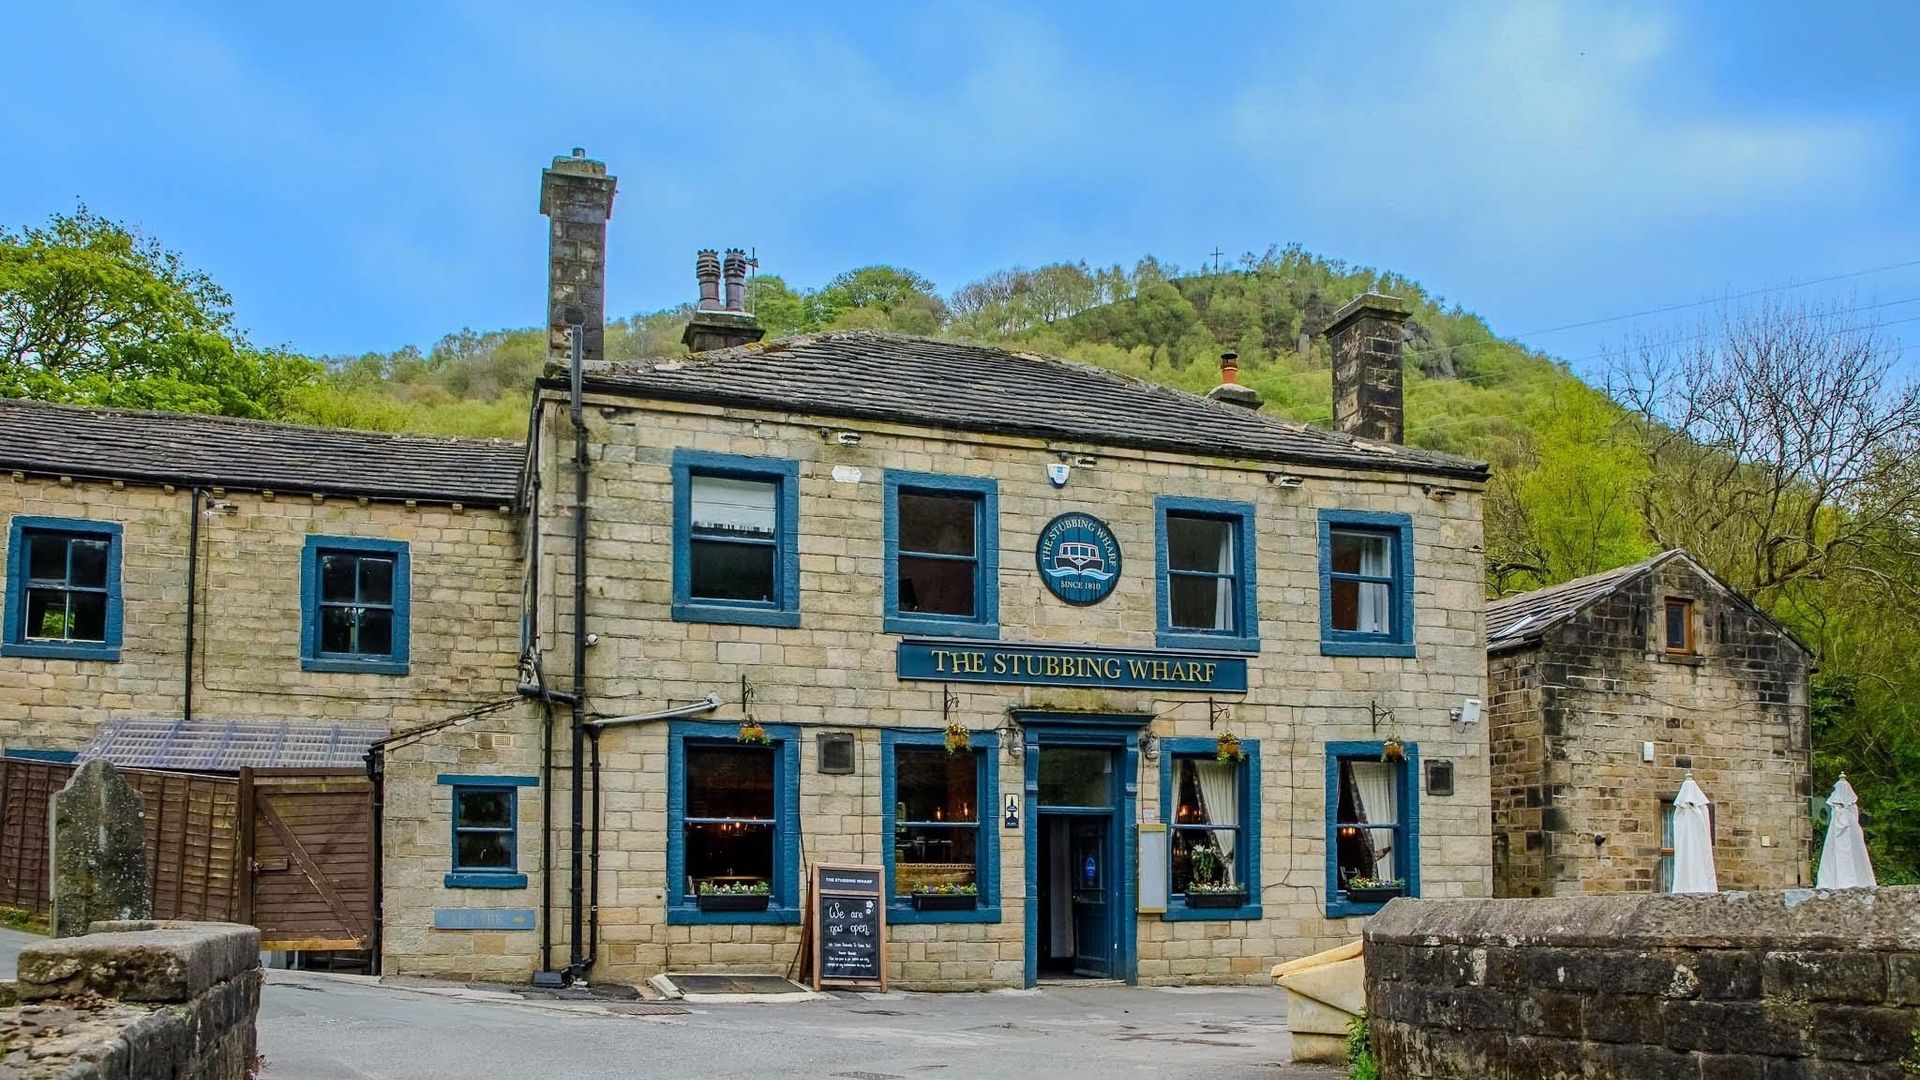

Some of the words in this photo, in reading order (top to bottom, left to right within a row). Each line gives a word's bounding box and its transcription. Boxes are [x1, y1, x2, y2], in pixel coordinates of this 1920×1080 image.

[1043, 539, 1054, 562] THE
[1049, 518, 1096, 539] STUBBING
[1096, 528, 1117, 567] WHARF
[1060, 580, 1083, 589] SINCE
[1084, 582, 1101, 590] 1810
[931, 650, 987, 674] THE
[994, 653, 1122, 680] STUBBING
[1127, 658, 1217, 683] WHARF
[829, 902, 845, 918] We
[850, 911, 864, 919] are
[829, 924, 842, 936] now
[850, 924, 870, 936] open
